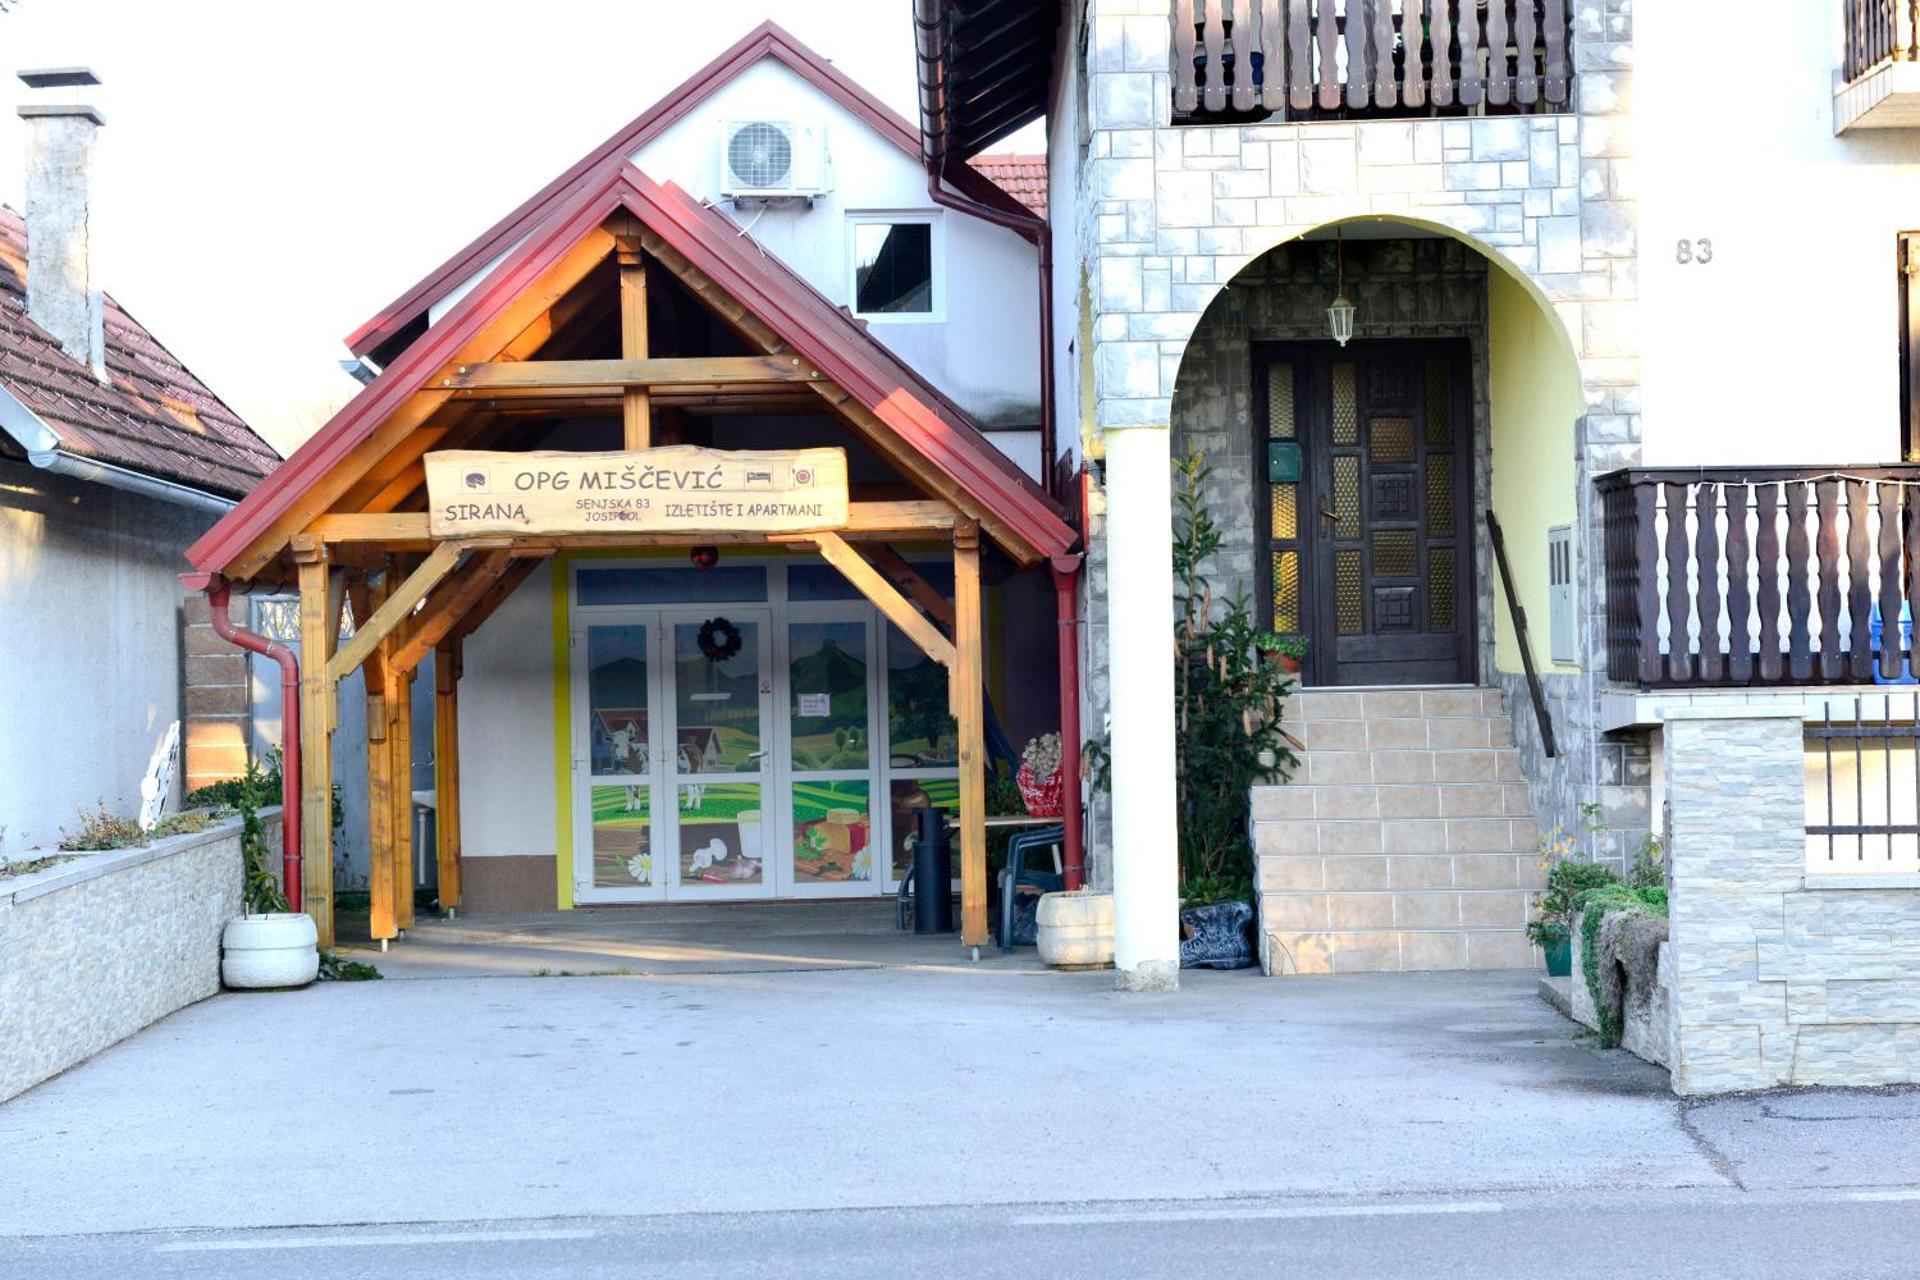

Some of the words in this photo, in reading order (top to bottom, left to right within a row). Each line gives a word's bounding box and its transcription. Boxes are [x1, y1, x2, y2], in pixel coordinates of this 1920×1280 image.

[1676, 237, 1713, 265] 83
[514, 471, 570, 491] OPG
[579, 464, 724, 490] MIŠČEVIĆ
[445, 503, 525, 521] SIRANA
[575, 498, 632, 510] SENJSKA
[635, 498, 650, 509] 83
[665, 500, 733, 517] IZLETIŠTE
[736, 504, 743, 517] I
[747, 503, 823, 517] APARTMANI
